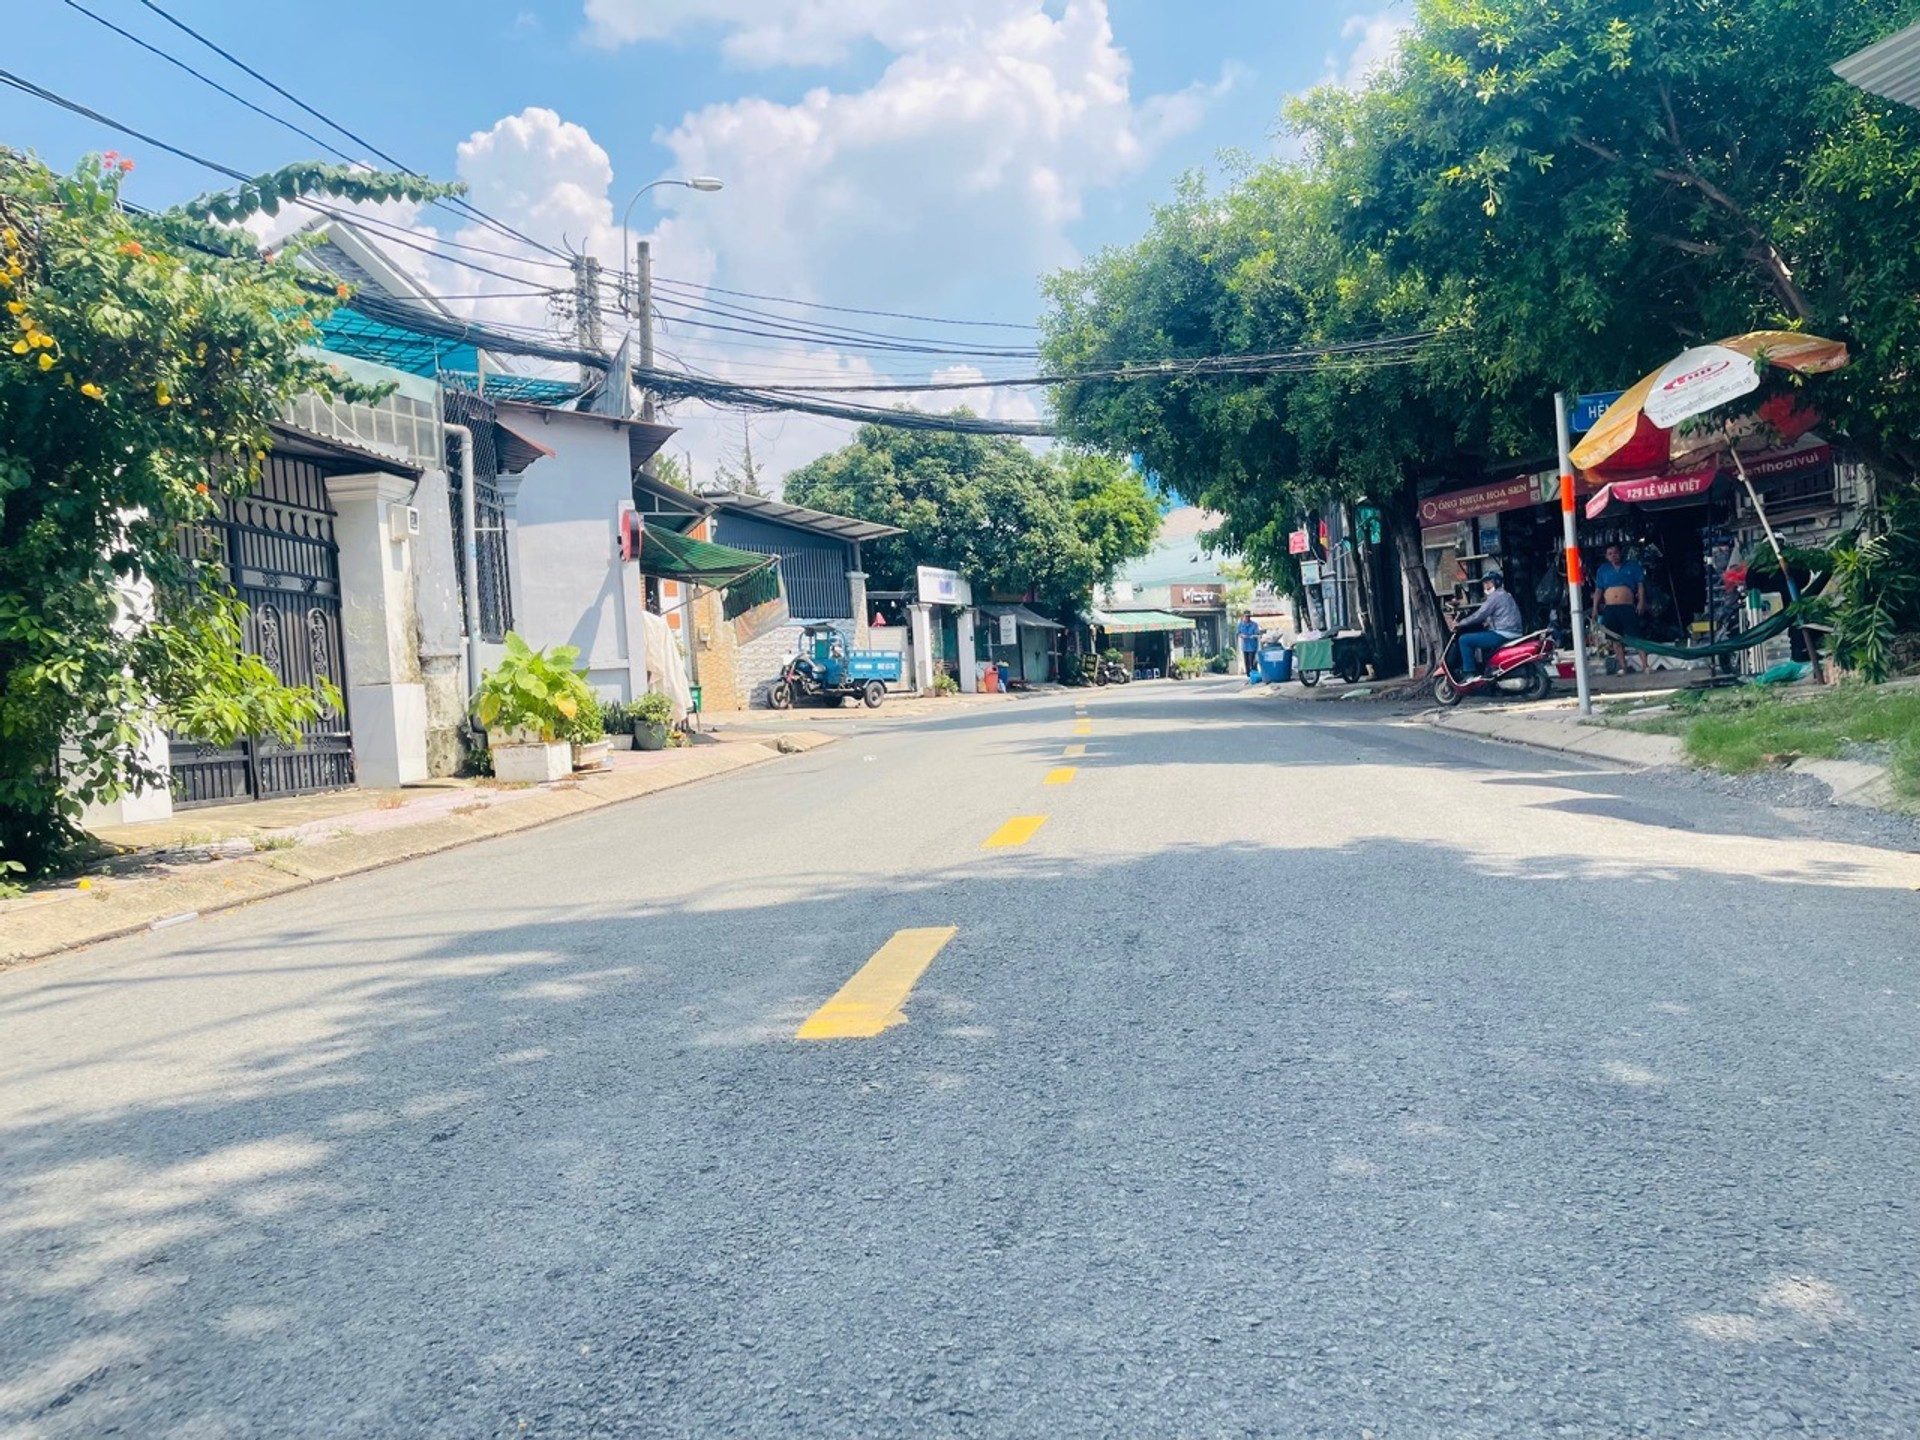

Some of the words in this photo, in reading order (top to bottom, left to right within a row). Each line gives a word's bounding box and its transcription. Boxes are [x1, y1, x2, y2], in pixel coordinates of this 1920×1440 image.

[1486, 489, 1506, 500] HOA
[1507, 484, 1527, 495] SEN
[1644, 483, 1656, 497] LÊ
[1657, 482, 1677, 495] VĂN
[1679, 478, 1700, 492] VIỆT
